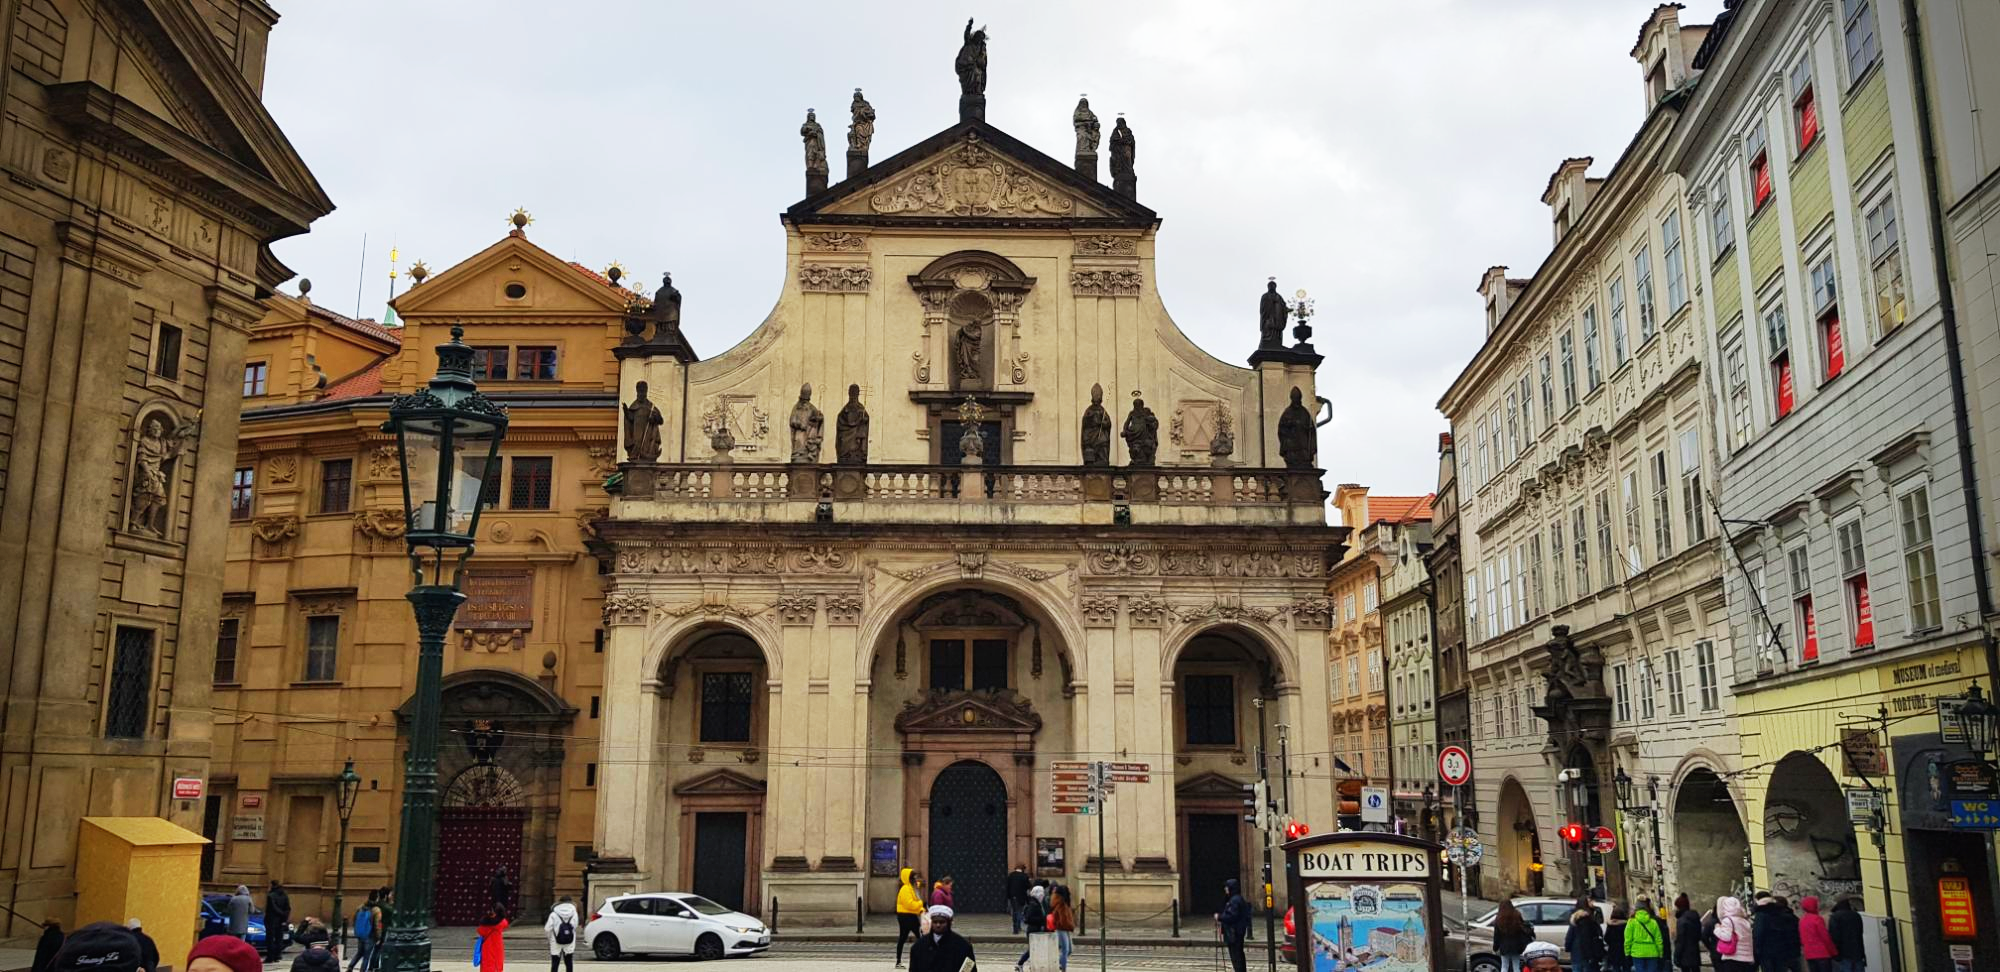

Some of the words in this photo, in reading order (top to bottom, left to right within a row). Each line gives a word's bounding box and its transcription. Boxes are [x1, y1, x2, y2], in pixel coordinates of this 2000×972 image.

[1893, 664, 1927, 684] MUSEUM
[1893, 694, 1927, 712] TORTURE
[1963, 802, 1989, 812] WC
[1303, 853, 1354, 871] BOAT
[1362, 853, 1425, 872] TRIPS
